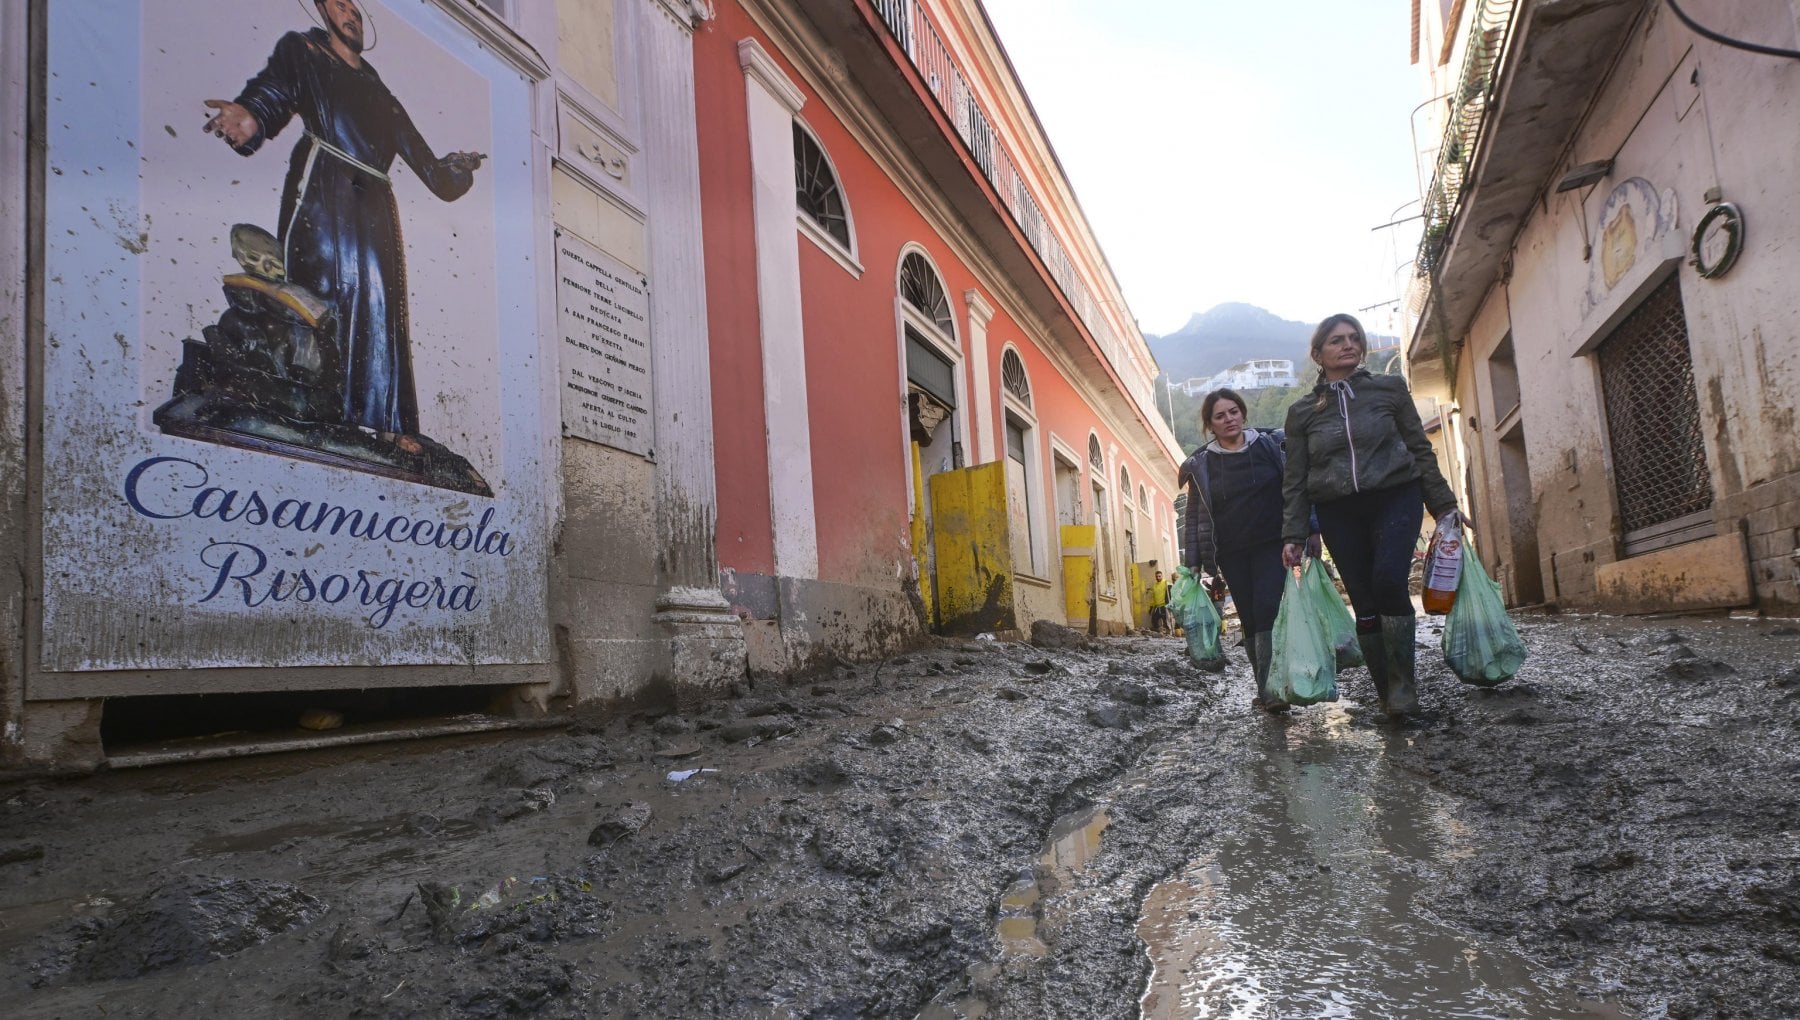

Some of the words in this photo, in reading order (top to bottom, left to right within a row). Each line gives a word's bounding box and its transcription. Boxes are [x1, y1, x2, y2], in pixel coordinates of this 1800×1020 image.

[562, 248, 584, 264] QUESTA
[585, 261, 612, 279] CAPPELLA
[563, 277, 592, 296] PENSIONE
[594, 292, 612, 306] TERME
[595, 279, 614, 294] DELLA
[565, 306, 569, 314] A
[572, 310, 585, 321] SAN
[587, 317, 621, 337] FRANCESCO
[590, 304, 622, 324] DEDICATA
[590, 346, 603, 356] DON
[601, 338, 623, 352] ERETTA
[572, 368, 584, 378] DAL
[588, 374, 615, 389] VESCOVO
[601, 394, 625, 408] GIUSEPPE
[582, 402, 605, 415] APERTA
[607, 410, 615, 418] AL
[618, 414, 637, 425] CULTO
[582, 415, 589, 423] IL
[600, 421, 621, 433] LUGLIO
[124, 456, 515, 557] Casamicciola
[199, 541, 482, 629] Risorgerà
